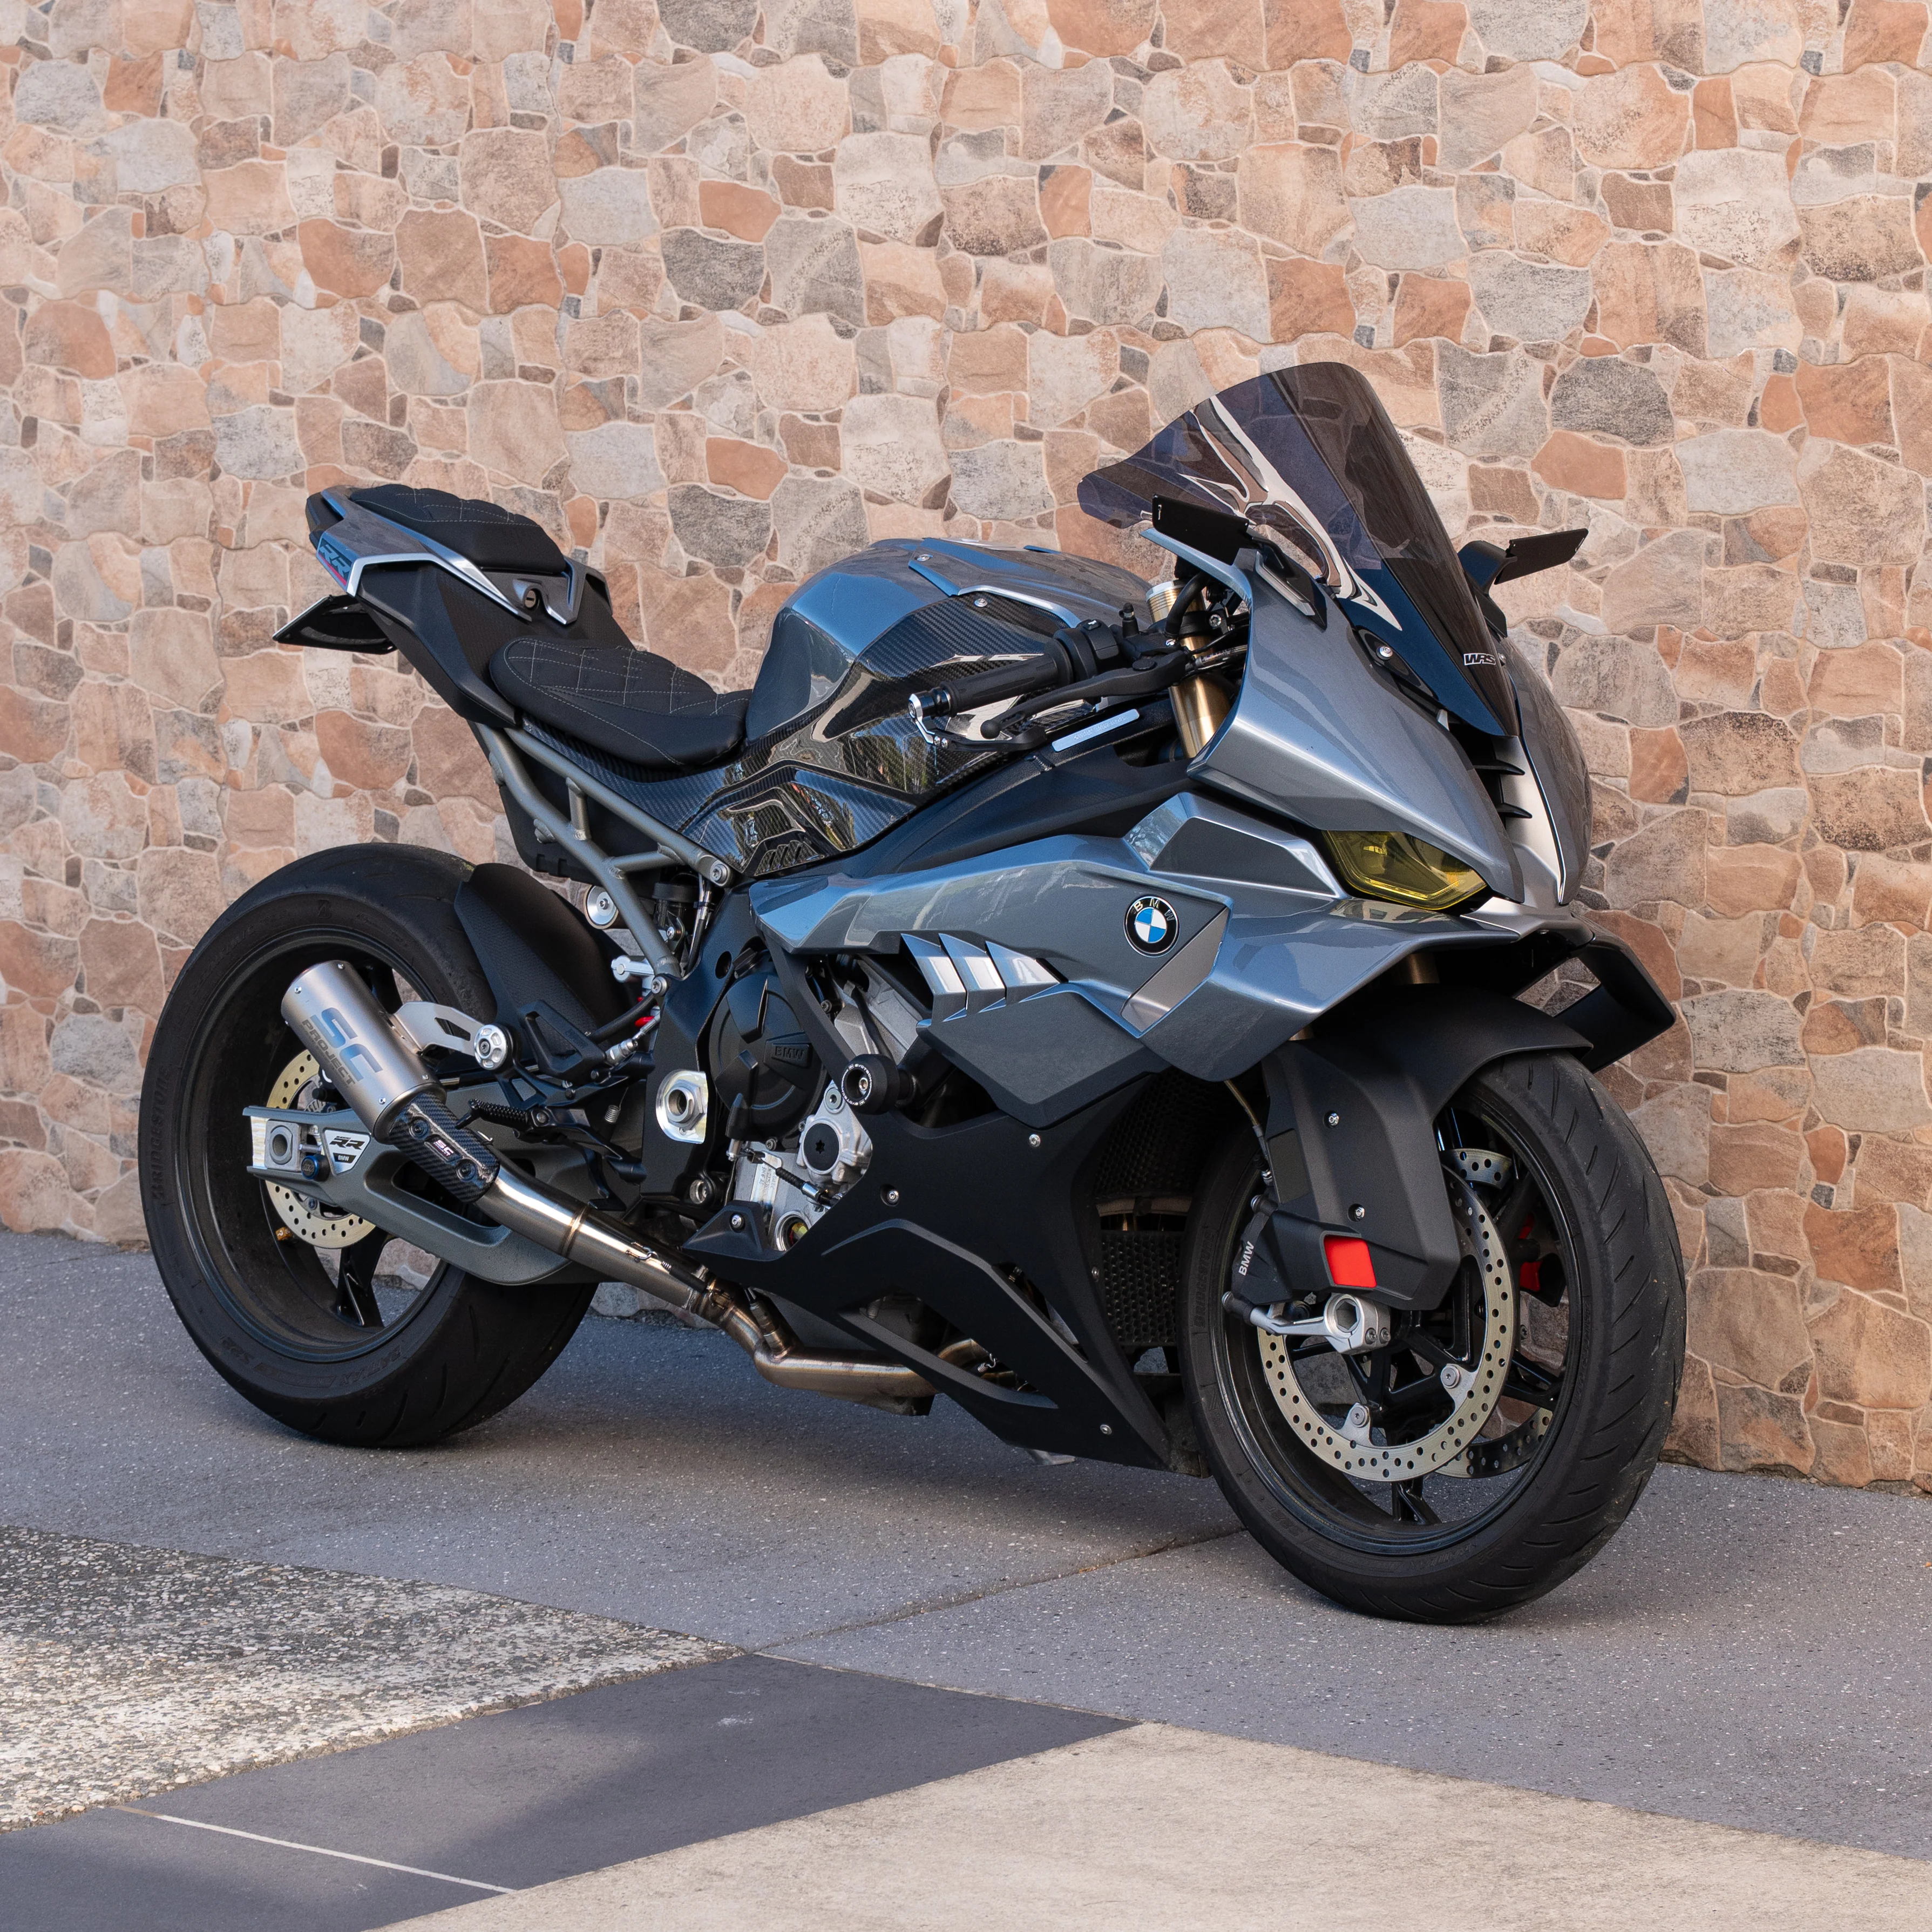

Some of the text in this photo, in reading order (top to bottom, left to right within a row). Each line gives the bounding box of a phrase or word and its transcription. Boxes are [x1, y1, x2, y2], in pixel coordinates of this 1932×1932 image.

[319, 544, 350, 578] RR
[1463, 653, 1496, 666] WRS
[1133, 897, 1175, 921] BMW
[302, 1019, 356, 1085] PROJECT
[309, 1007, 384, 1082] SC
[775, 1046, 804, 1061] BMW
[150, 1067, 169, 1201] BRIDGESTONE
[329, 1137, 365, 1150] RR
[1238, 1240, 1255, 1276] BMW
[1193, 1231, 1215, 1328] BRIDGESTONE
